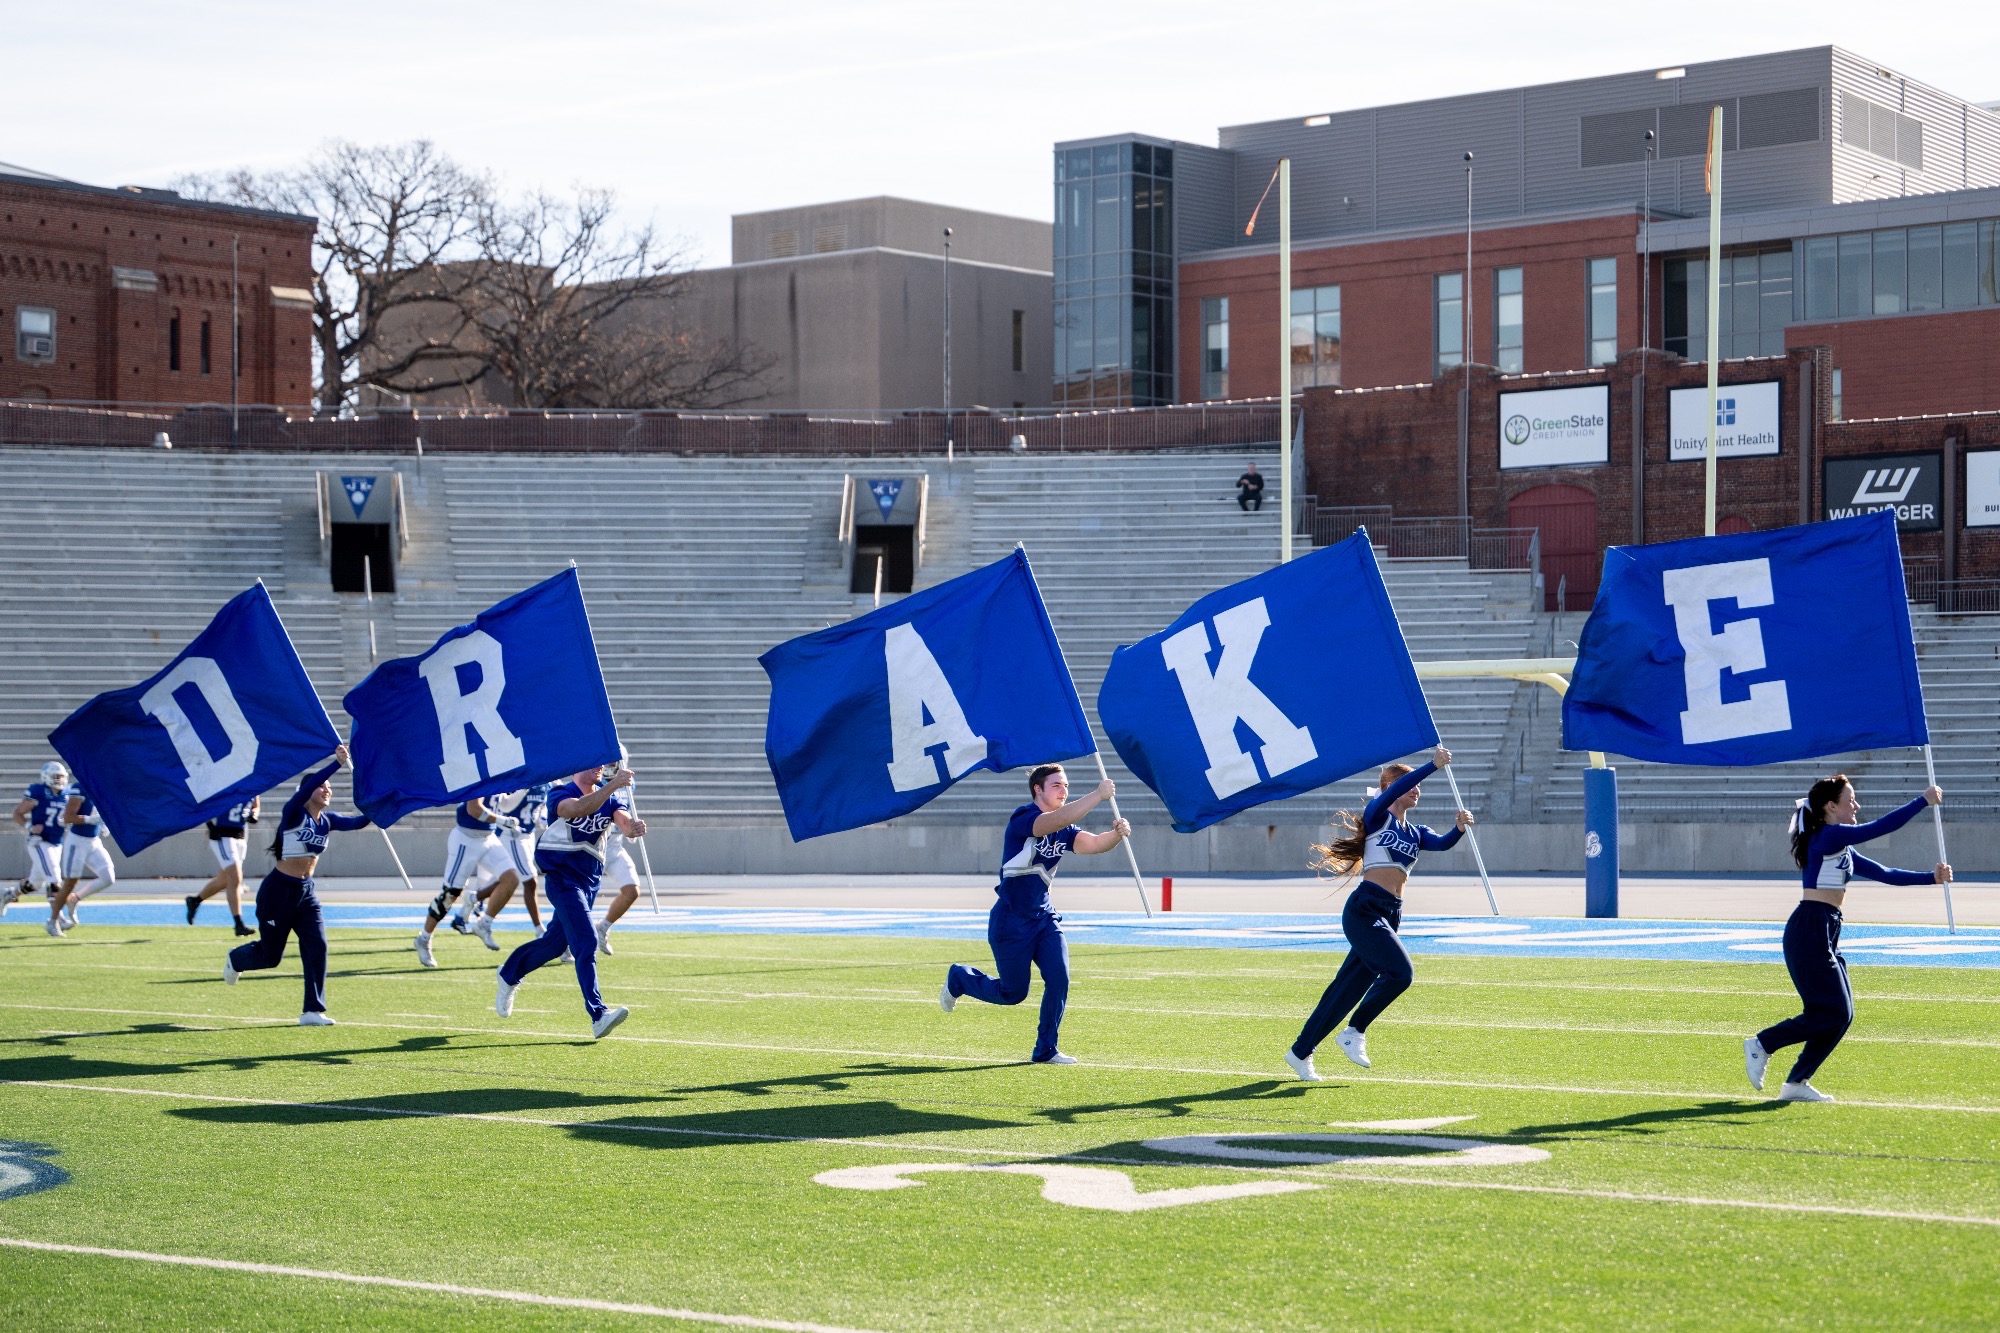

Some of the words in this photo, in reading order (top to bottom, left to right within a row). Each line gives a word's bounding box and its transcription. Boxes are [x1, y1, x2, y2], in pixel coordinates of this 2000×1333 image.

[1532, 414, 1604, 431] GreenState
[1533, 431, 1563, 440] CREDIT
[1567, 429, 1595, 438] UNION
[1674, 436, 1734, 450] Unityint
[1738, 432, 1775, 446] Health
[1829, 504, 1935, 521] WADGER
[419, 629, 525, 793] R
[886, 622, 988, 793] A
[1161, 596, 1319, 801] K
[1662, 557, 1792, 745] E
[139, 657, 259, 803] D
